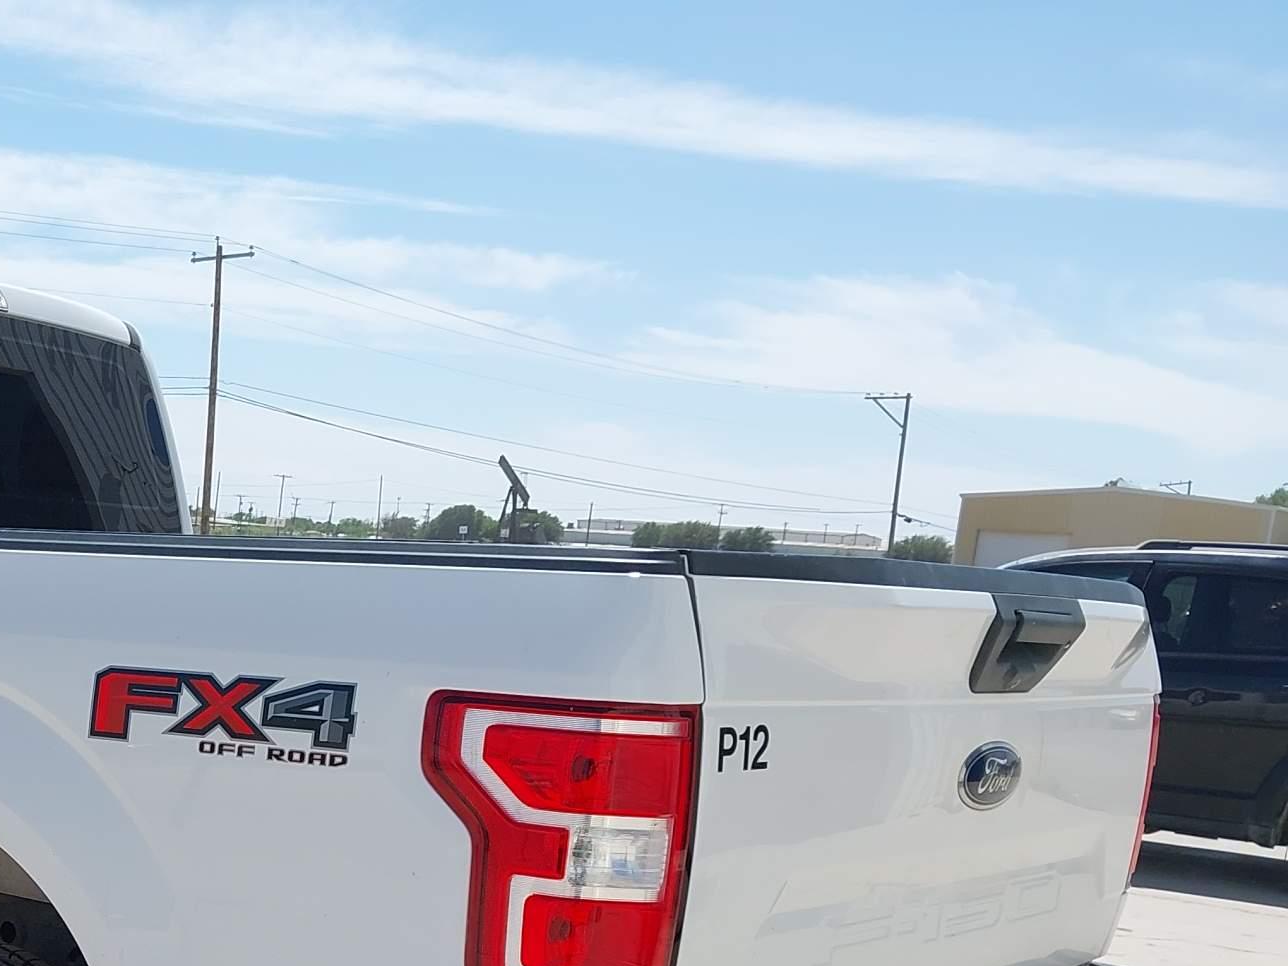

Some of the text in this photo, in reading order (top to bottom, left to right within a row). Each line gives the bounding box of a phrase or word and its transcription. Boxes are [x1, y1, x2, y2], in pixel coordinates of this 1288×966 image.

[88, 665, 358, 751] FX4
[198, 740, 349, 768] OFF ROAD
[716, 724, 770, 772] P12
[977, 756, 1016, 794] Ford
